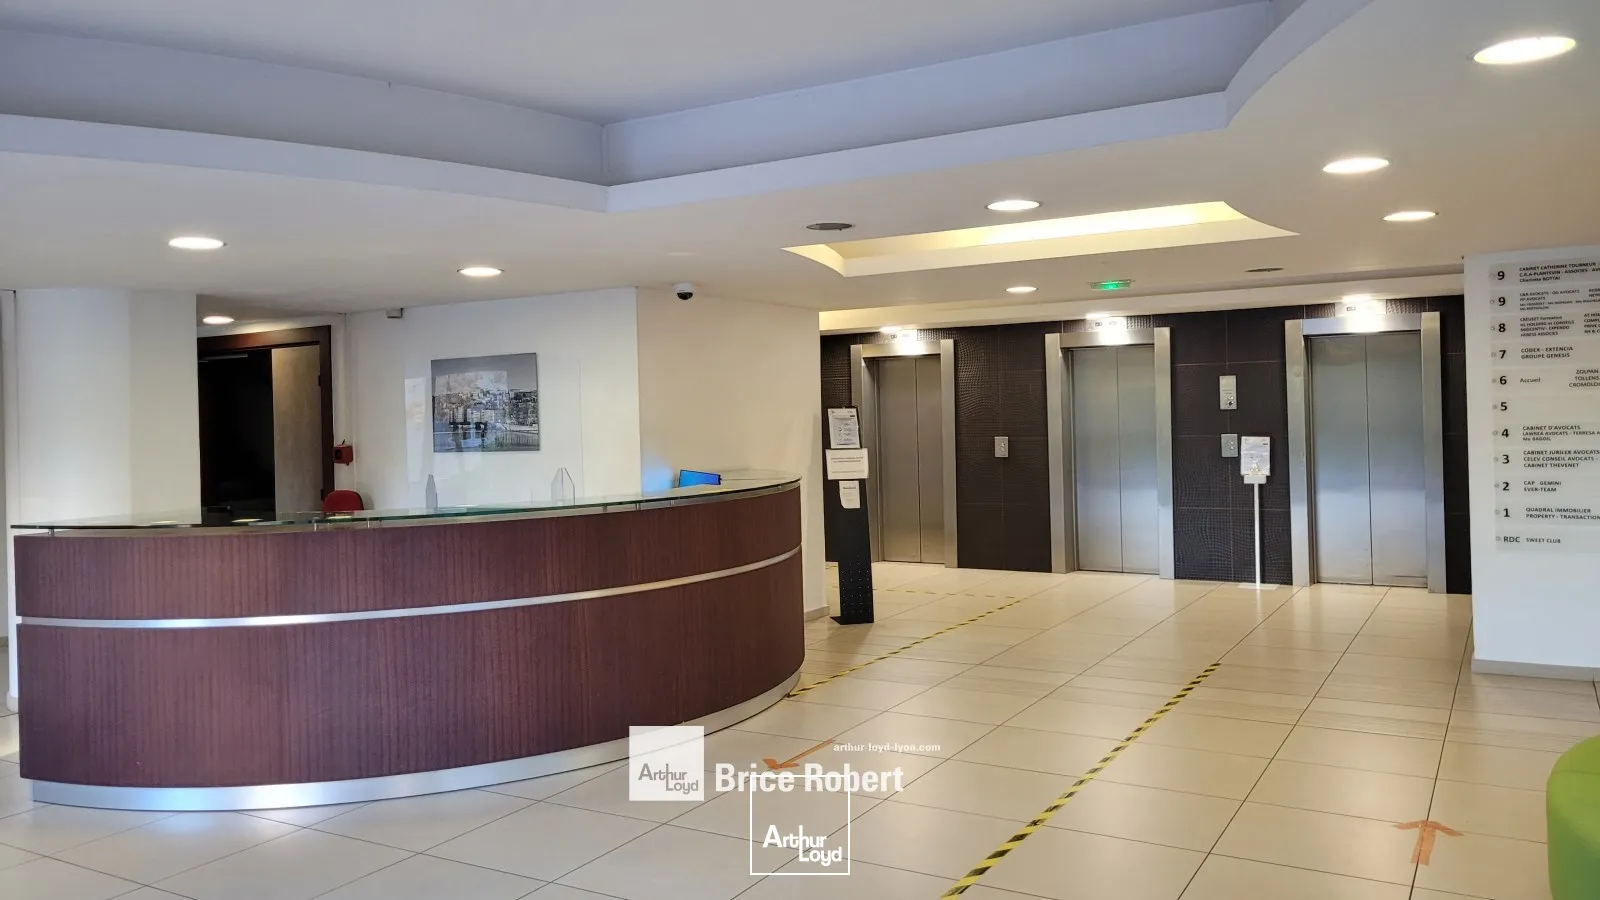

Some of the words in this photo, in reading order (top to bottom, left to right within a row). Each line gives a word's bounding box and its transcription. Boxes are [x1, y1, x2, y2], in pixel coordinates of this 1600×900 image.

[1497, 271, 1505, 280] 9
[1498, 297, 1506, 306] 9
[1498, 324, 1506, 332] 8
[1499, 350, 1506, 359] 7
[1500, 376, 1507, 385] 6
[1500, 402, 1508, 411] 5
[1501, 428, 1509, 438] 4
[1502, 454, 1510, 464] 3
[1502, 482, 1510, 491] 2
[1504, 508, 1510, 517] 1
